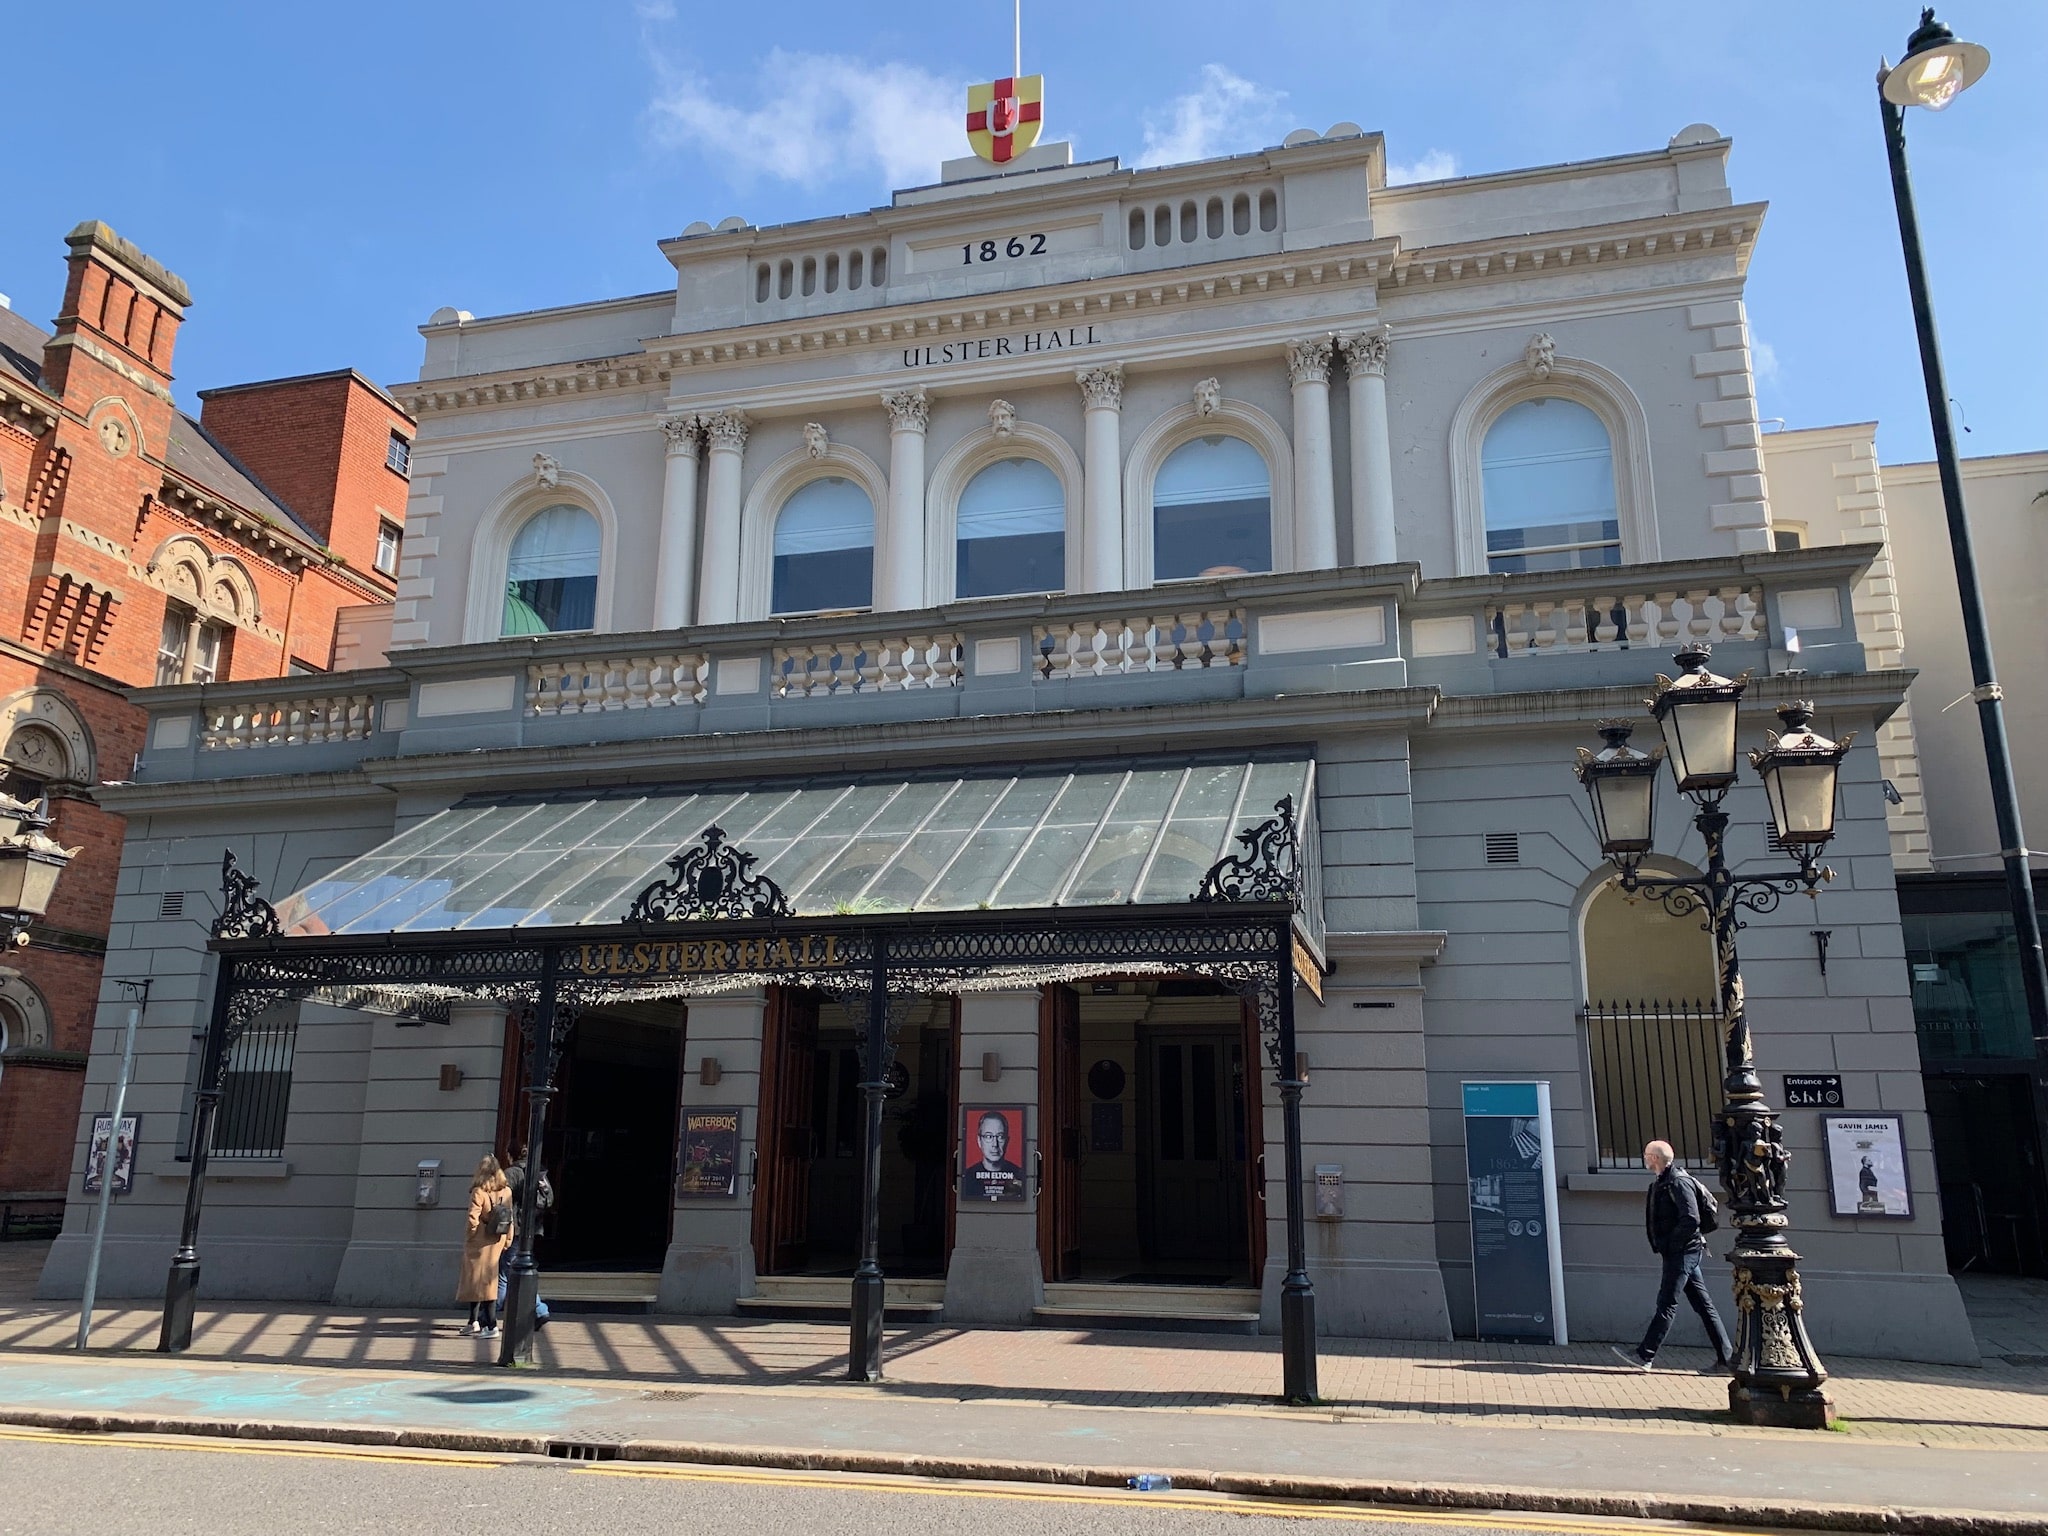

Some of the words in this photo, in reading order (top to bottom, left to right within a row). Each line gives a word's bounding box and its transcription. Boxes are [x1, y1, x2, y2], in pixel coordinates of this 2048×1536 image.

[962, 234, 1047, 265] 1862
[903, 337, 1013, 367] ULSTER
[1023, 326, 1101, 352] HALL
[579, 938, 728, 975] ULSTER
[735, 935, 847, 970] HALL
[1919, 1021, 1951, 1031] STER
[96, 1120, 112, 1133] RUB
[687, 1116, 737, 1132] WATERBOYS
[1489, 1158, 1519, 1169] 1862
[976, 1171, 990, 1179] BEN
[991, 1171, 1014, 1179] ELTON
